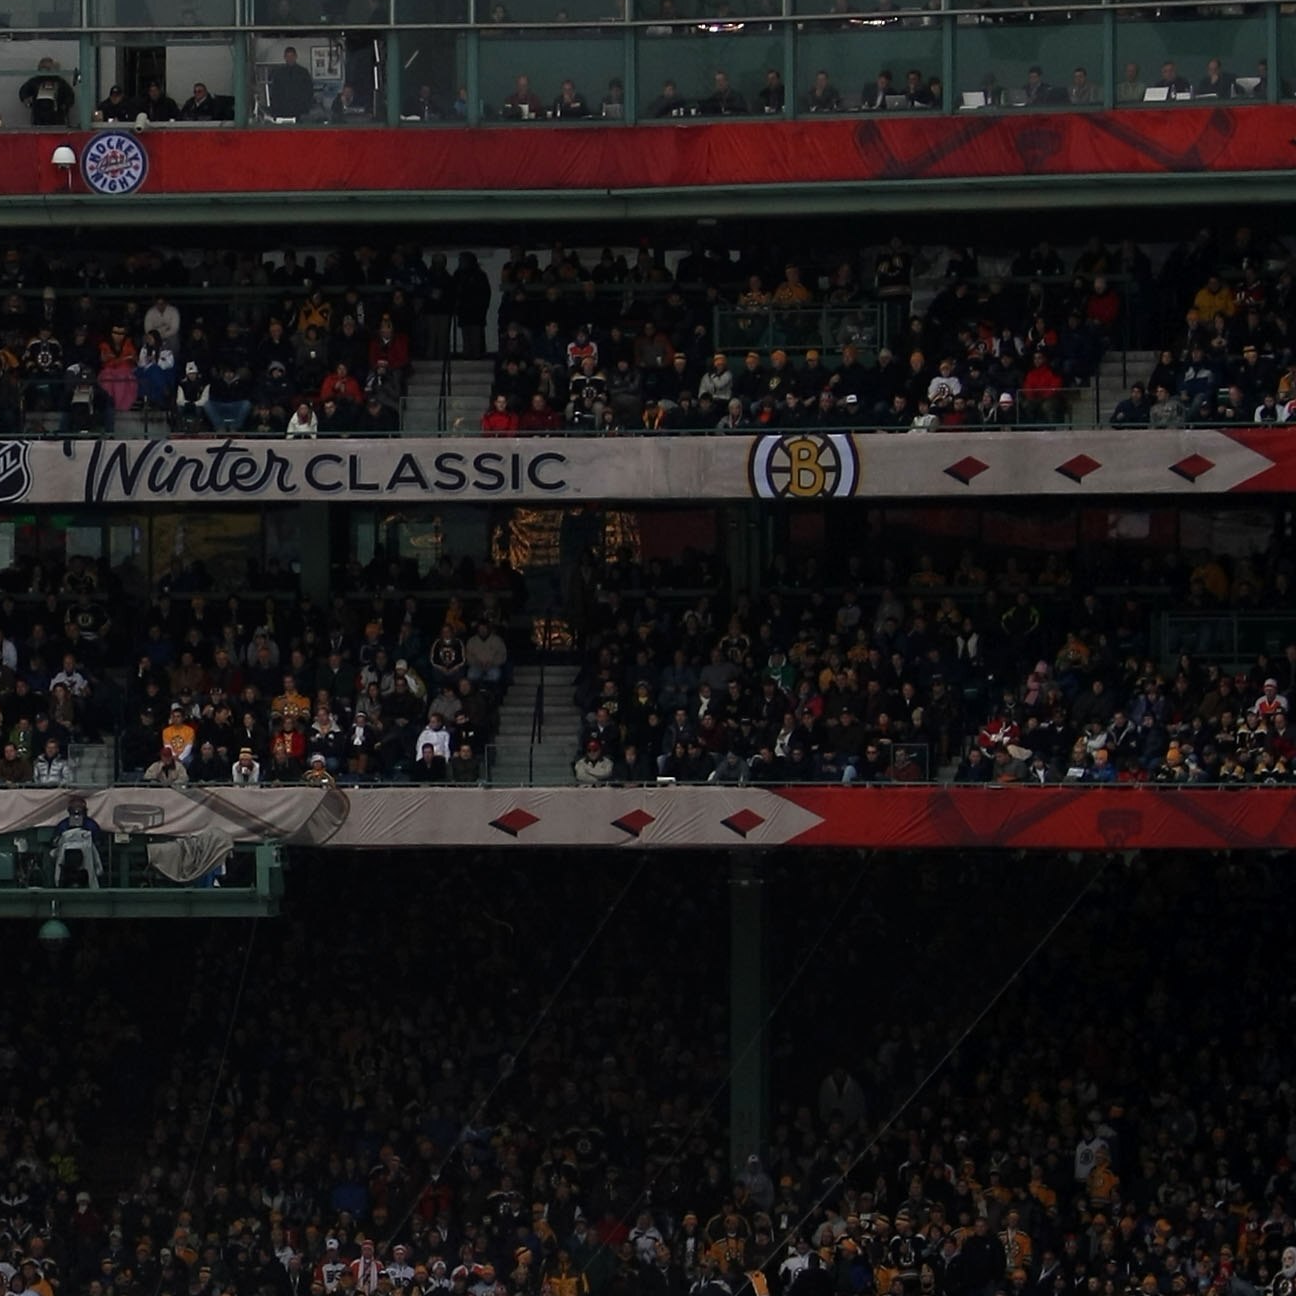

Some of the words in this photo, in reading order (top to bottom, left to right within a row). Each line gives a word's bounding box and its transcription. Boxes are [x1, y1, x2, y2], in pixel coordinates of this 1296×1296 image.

[88, 137, 141, 163] HOCKEY
[91, 171, 137, 191] NIGHT
[63, 438, 300, 502] Winter
[304, 452, 568, 491] CLASSIC
